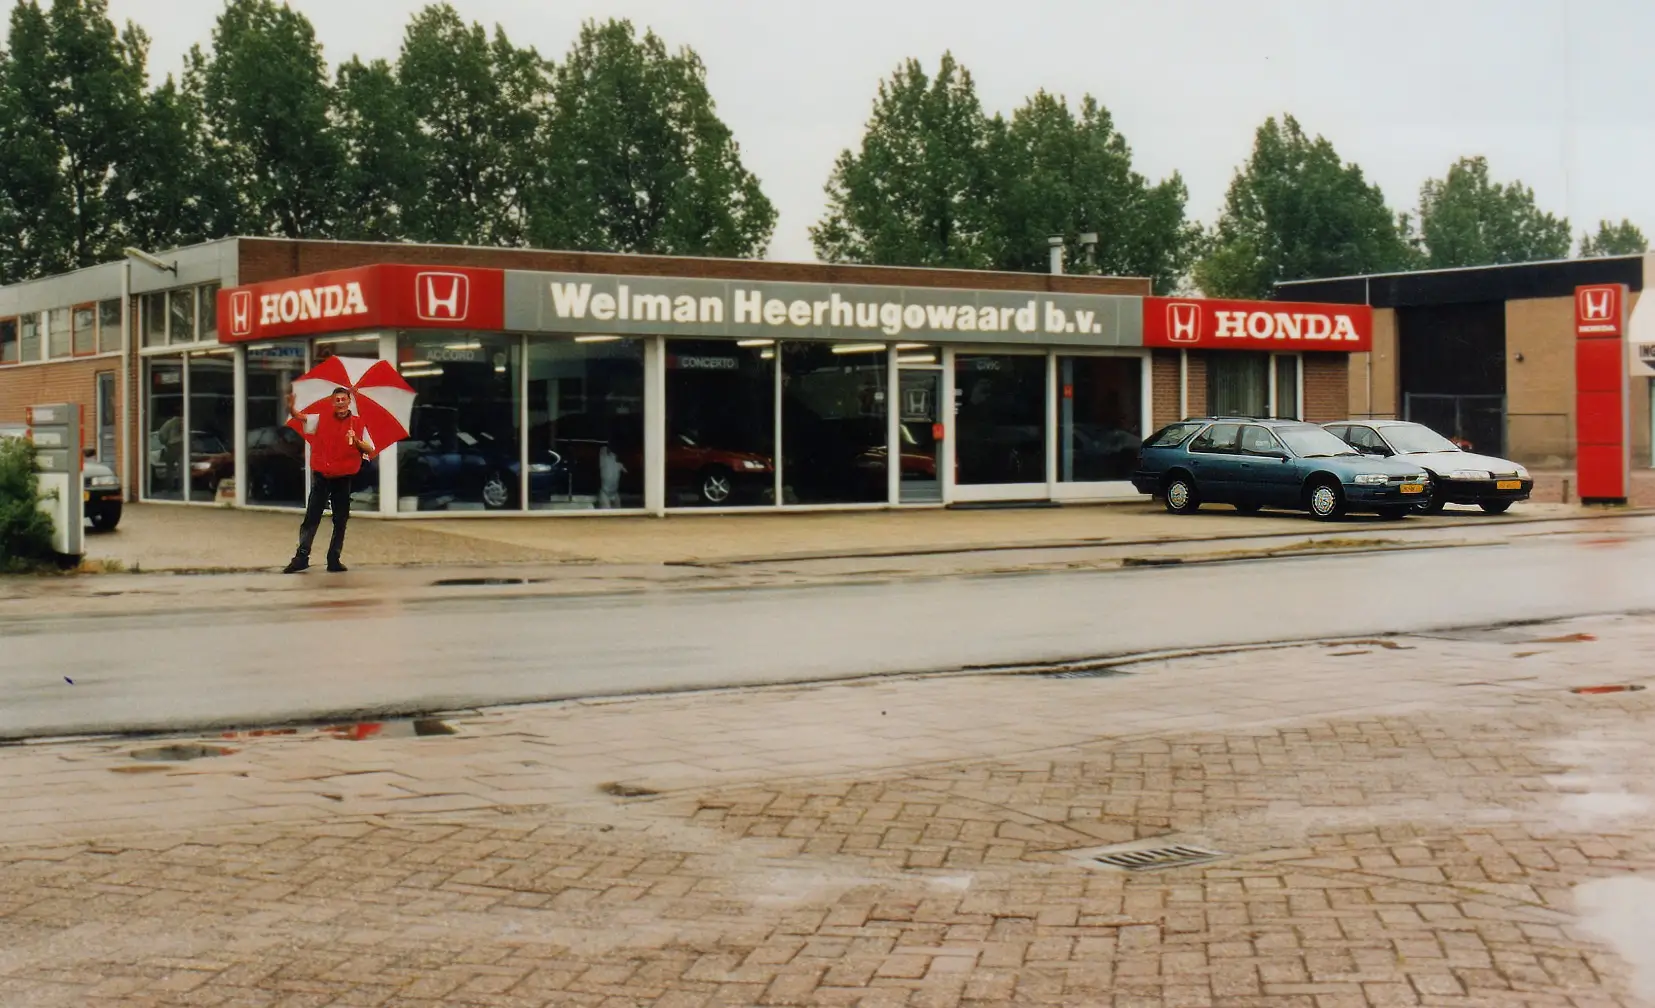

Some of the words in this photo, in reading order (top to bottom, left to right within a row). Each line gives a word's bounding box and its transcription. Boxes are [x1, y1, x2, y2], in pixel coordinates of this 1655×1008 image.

[259, 281, 368, 325] HONDA
[550, 282, 724, 323] Welman
[734, 289, 1037, 336] Heerhugowaard
[1045, 301, 1102, 334] b.v.
[1214, 311, 1360, 341] HONDA
[426, 349, 475, 362] ACCORD
